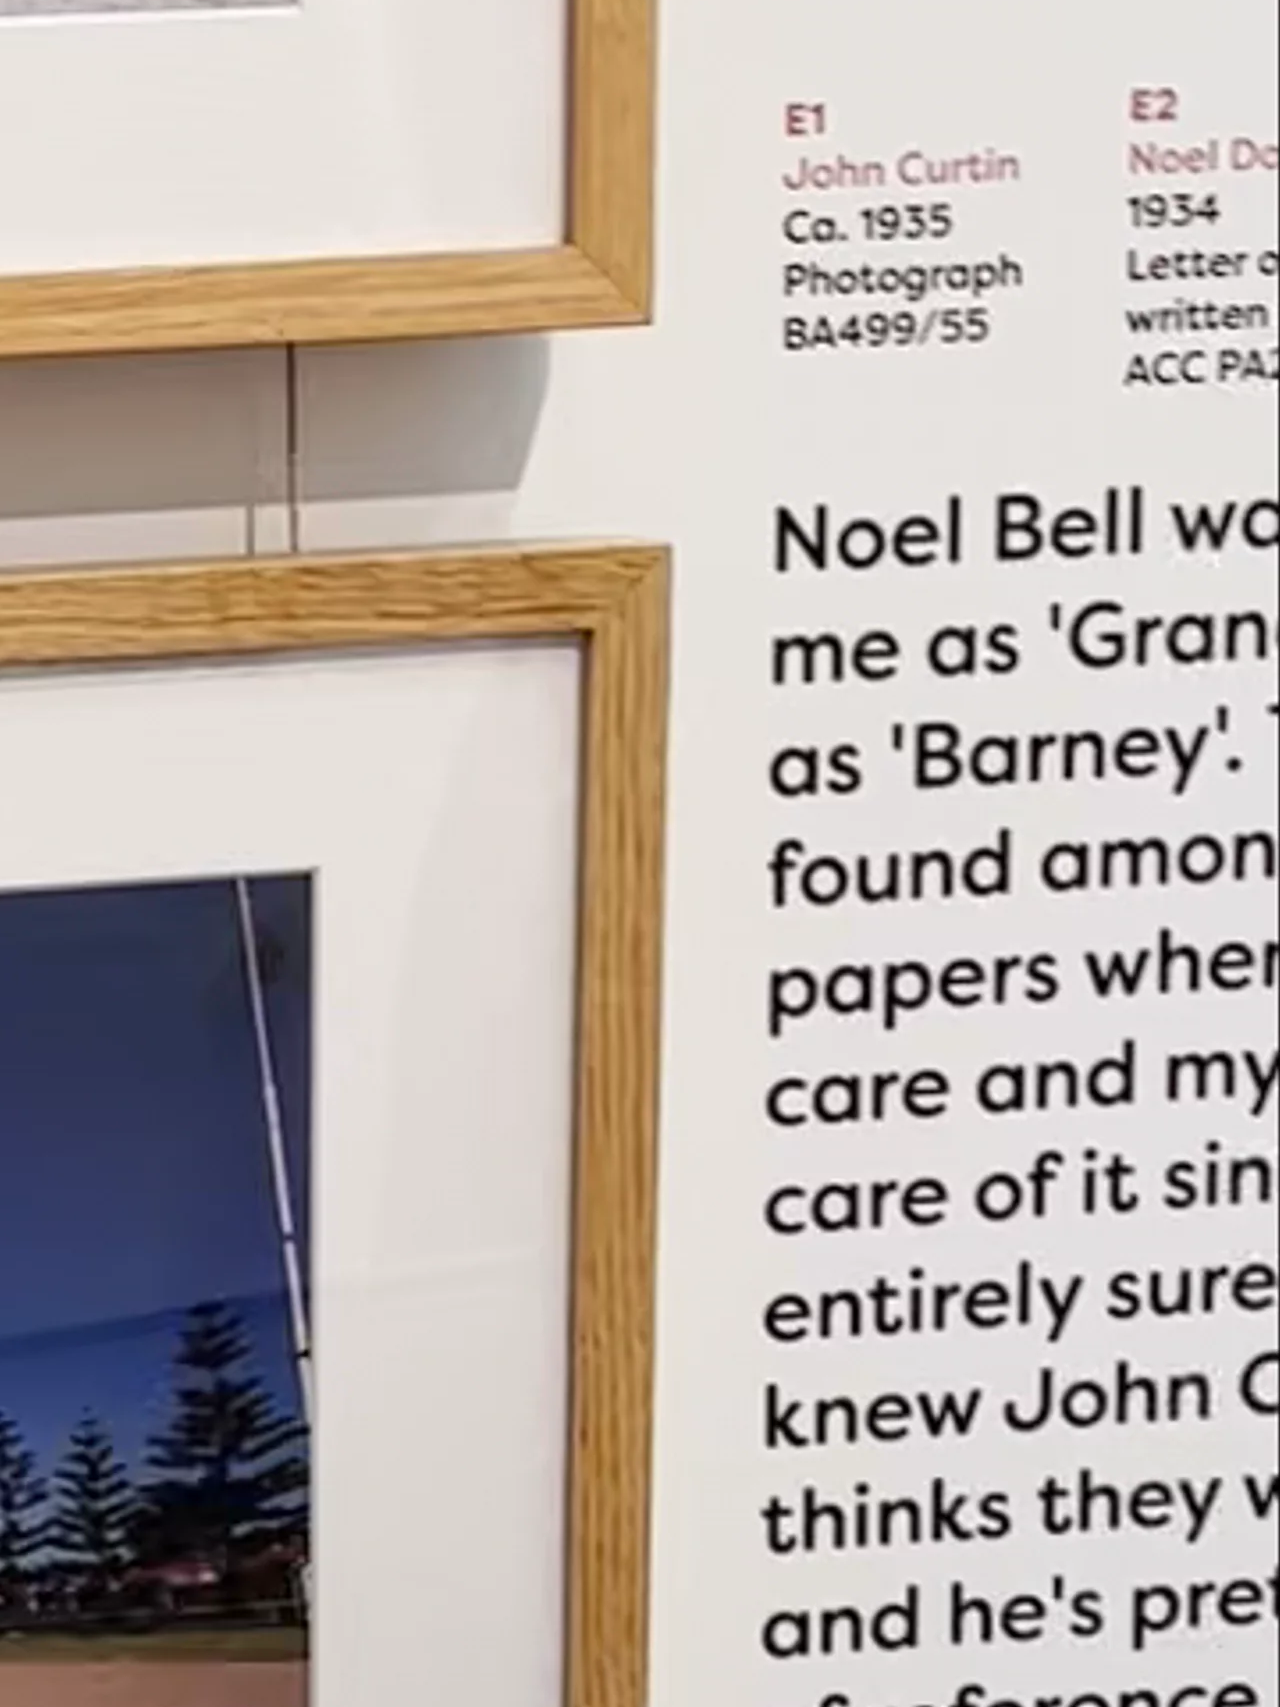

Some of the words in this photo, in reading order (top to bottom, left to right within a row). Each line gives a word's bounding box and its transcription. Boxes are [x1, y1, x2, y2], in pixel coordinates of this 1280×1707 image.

[785, 102, 825, 137] E1
[1129, 88, 1178, 122] E2
[782, 155, 885, 191] John
[897, 148, 1019, 186] Curtin
[1129, 140, 1218, 174] Noel
[782, 209, 848, 244] Ca.
[860, 203, 953, 240] 1935
[1127, 193, 1221, 228] 1934
[784, 254, 1023, 302] Photograph
[1127, 250, 1249, 281] Letter
[784, 307, 989, 351] BA499/55
[1125, 298, 1268, 333] written
[1123, 350, 1206, 385] ACC
[775, 494, 962, 573] Noel
[995, 485, 1143, 562] Bell
[772, 630, 901, 685] me
[926, 623, 1020, 678] as
[1049, 600, 1279, 670] 'Gran
[769, 743, 862, 798] as
[891, 705, 1243, 796] 'Barney'.
[767, 827, 1012, 908] found
[768, 953, 1060, 1039] papers
[765, 1069, 951, 1127] care
[976, 1038, 1136, 1114] and
[1166, 1049, 1279, 1117] my
[764, 1177, 949, 1236] care
[974, 1149, 1065, 1222] of
[1083, 1147, 1140, 1215] it
[1163, 1140, 1272, 1210] sin
[763, 1259, 1084, 1343] entirely
[1106, 1262, 1277, 1320] sure
[765, 1383, 982, 1449] knew
[1003, 1360, 1211, 1433] John
[760, 1477, 1012, 1555] thinks
[1037, 1468, 1223, 1544] they
[761, 1584, 920, 1660] and
[950, 1574, 1104, 1646] he's
